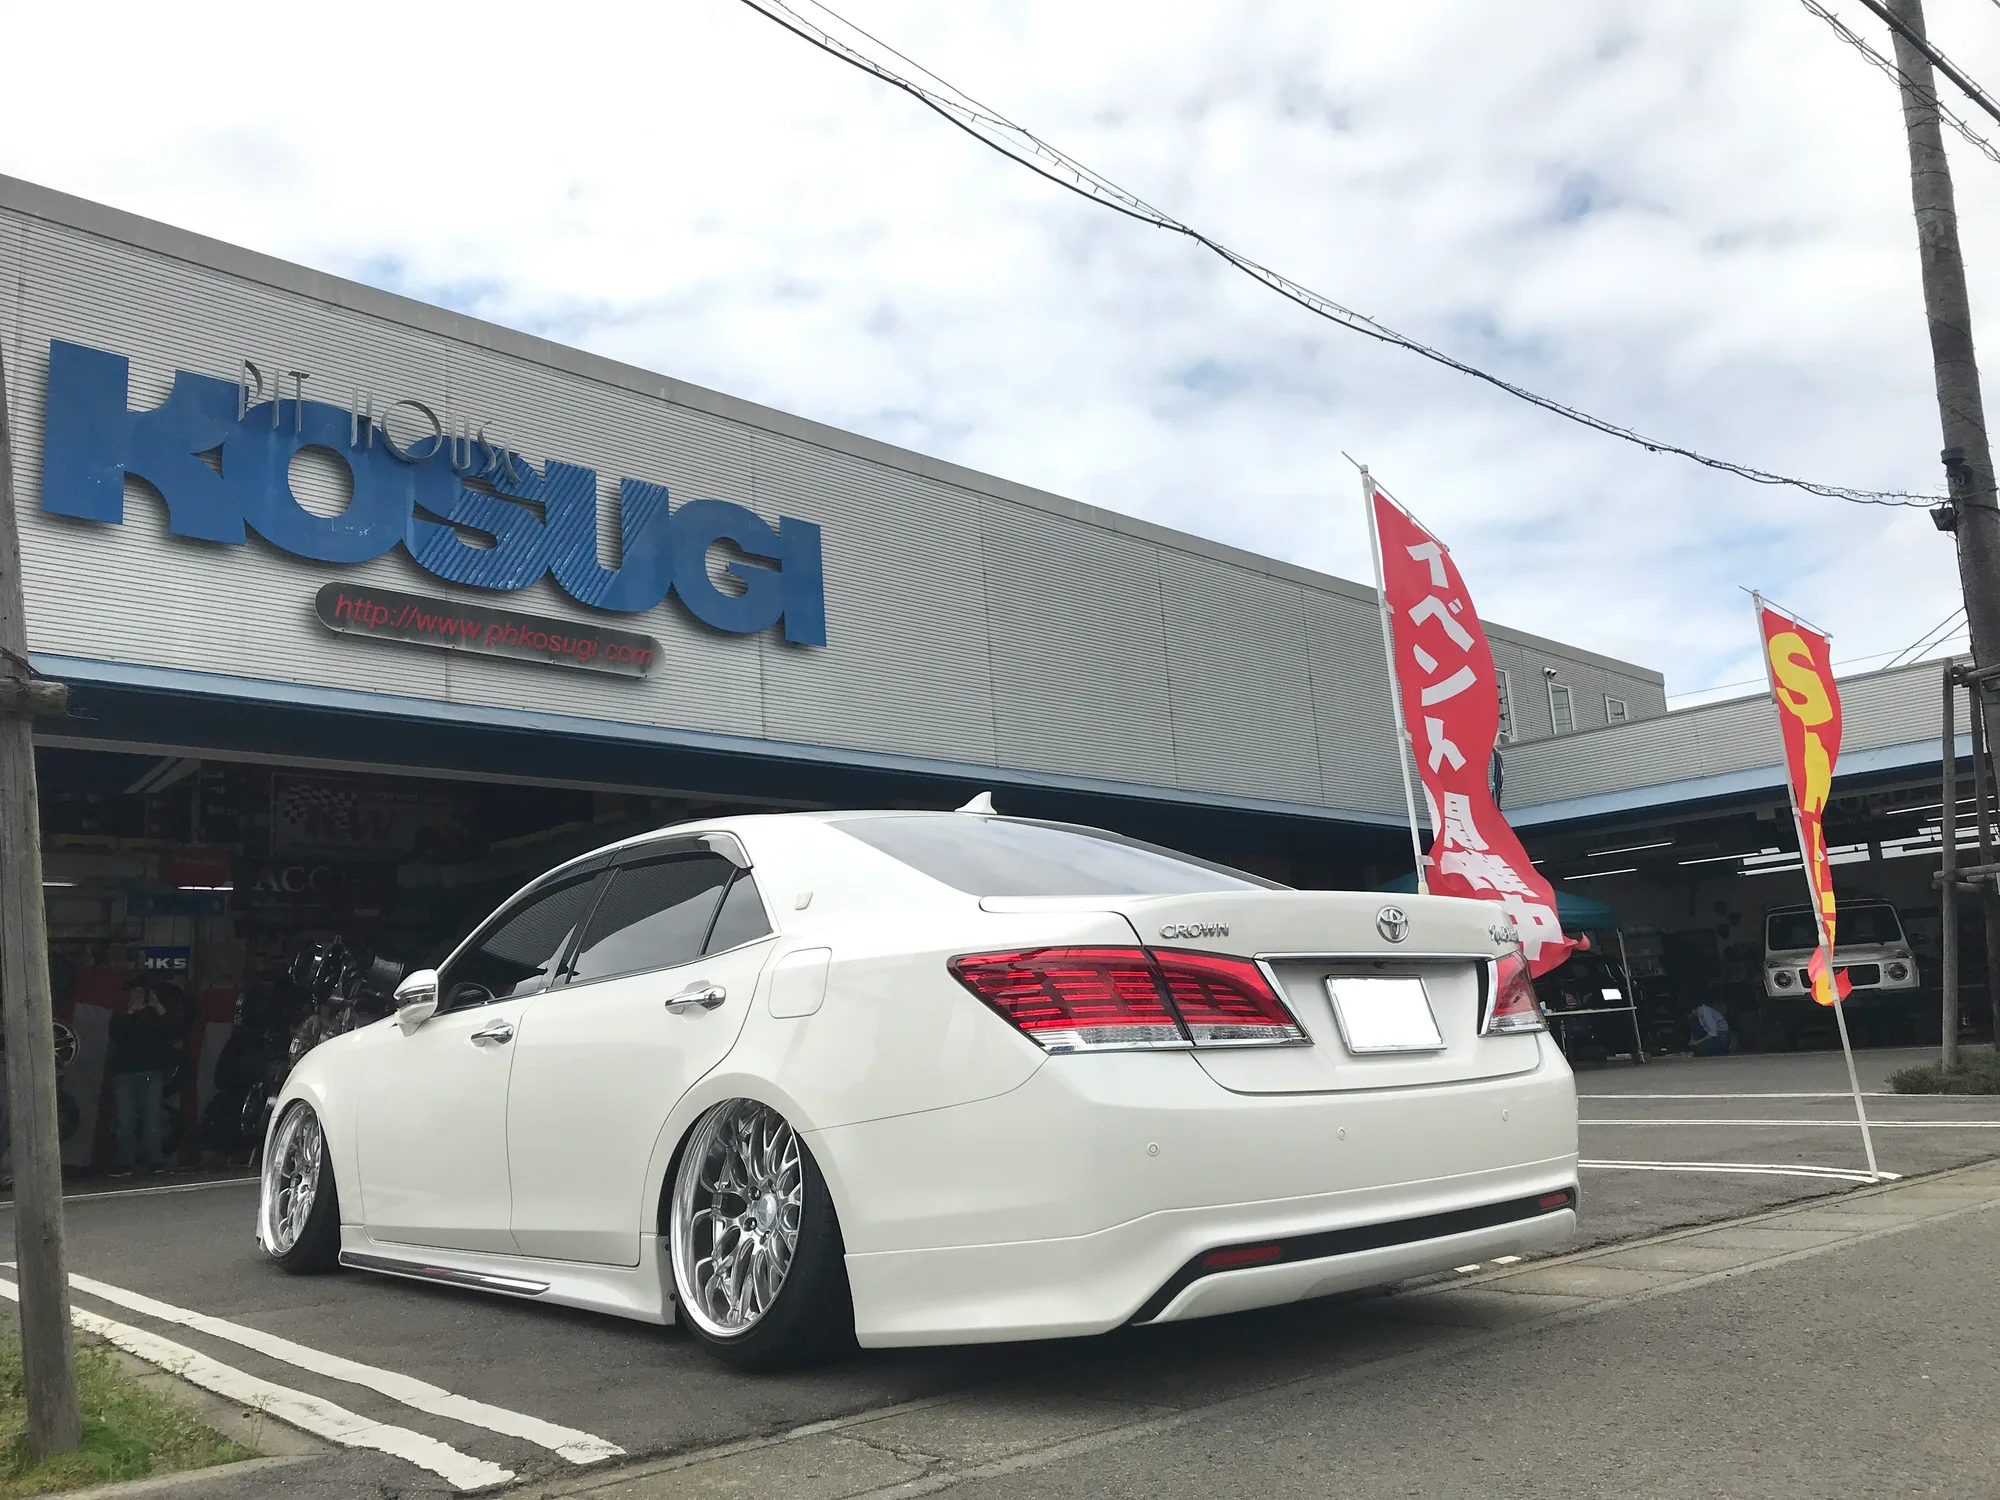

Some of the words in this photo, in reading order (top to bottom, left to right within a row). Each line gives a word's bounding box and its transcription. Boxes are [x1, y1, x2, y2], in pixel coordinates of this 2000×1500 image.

[238, 359, 310, 429] PIT
[42, 338, 827, 648] KOSUGI
[334, 593, 655, 666] http://www.phkosugi.com
[1405, 540, 1566, 961] イベント開催中
[1160, 923, 1229, 939] CROWN
